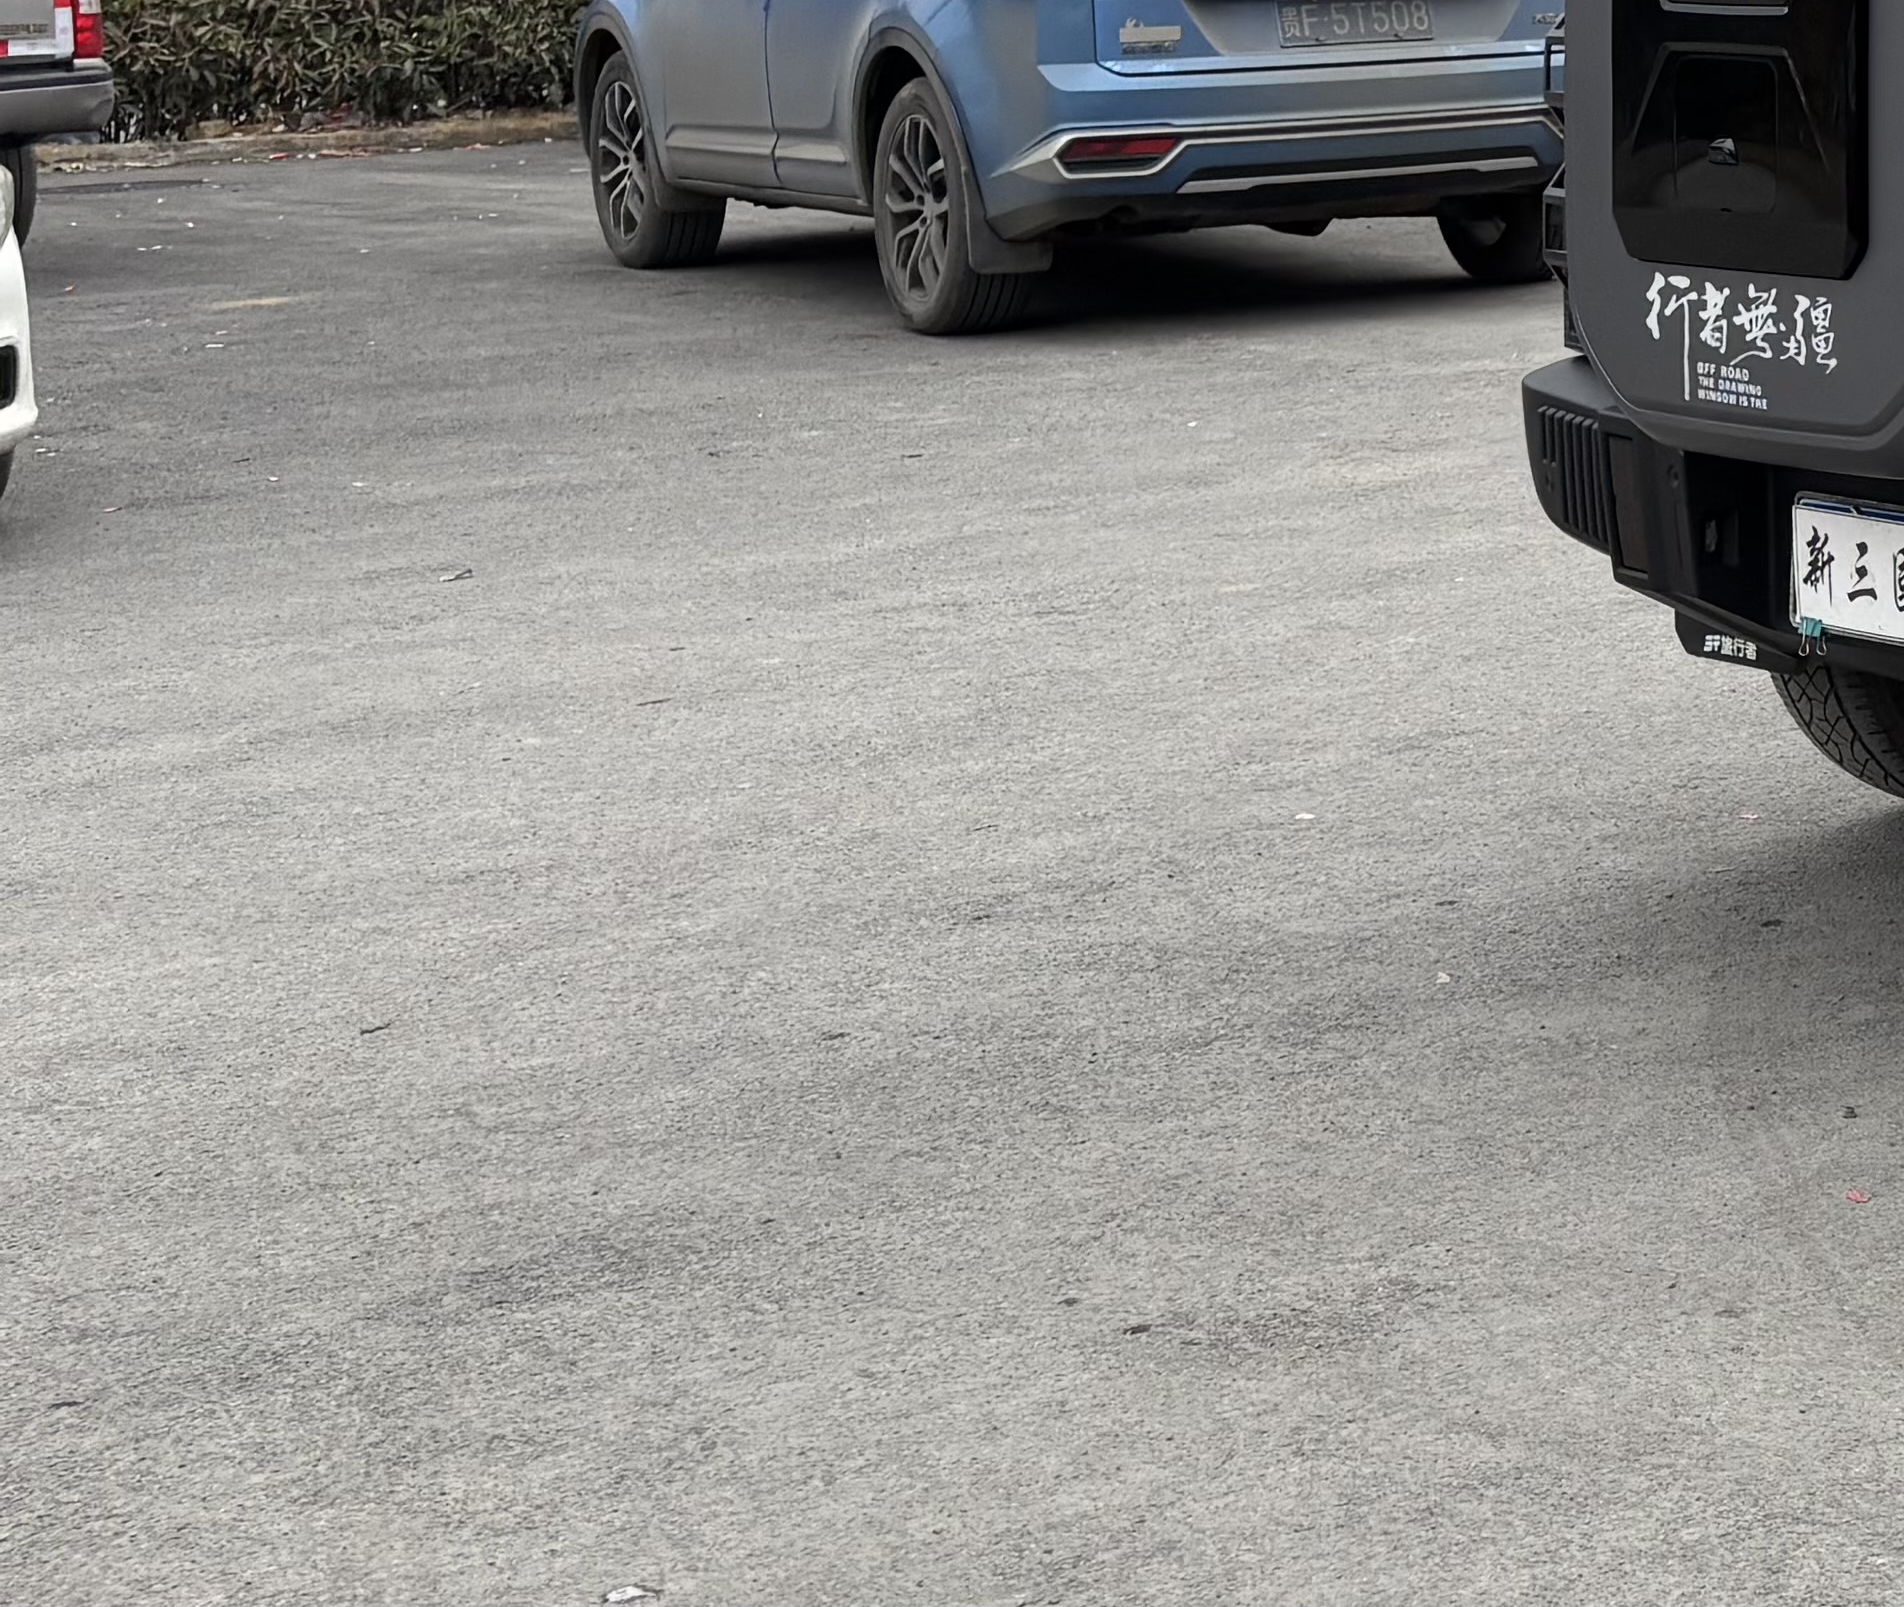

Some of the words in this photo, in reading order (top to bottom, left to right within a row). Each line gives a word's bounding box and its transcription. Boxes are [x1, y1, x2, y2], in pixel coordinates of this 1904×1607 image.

[1697, 361, 1716, 375] OFF
[1720, 365, 1750, 381] ROAD
[1698, 375, 1715, 389] THE
[1718, 379, 1762, 397] DRAWING
